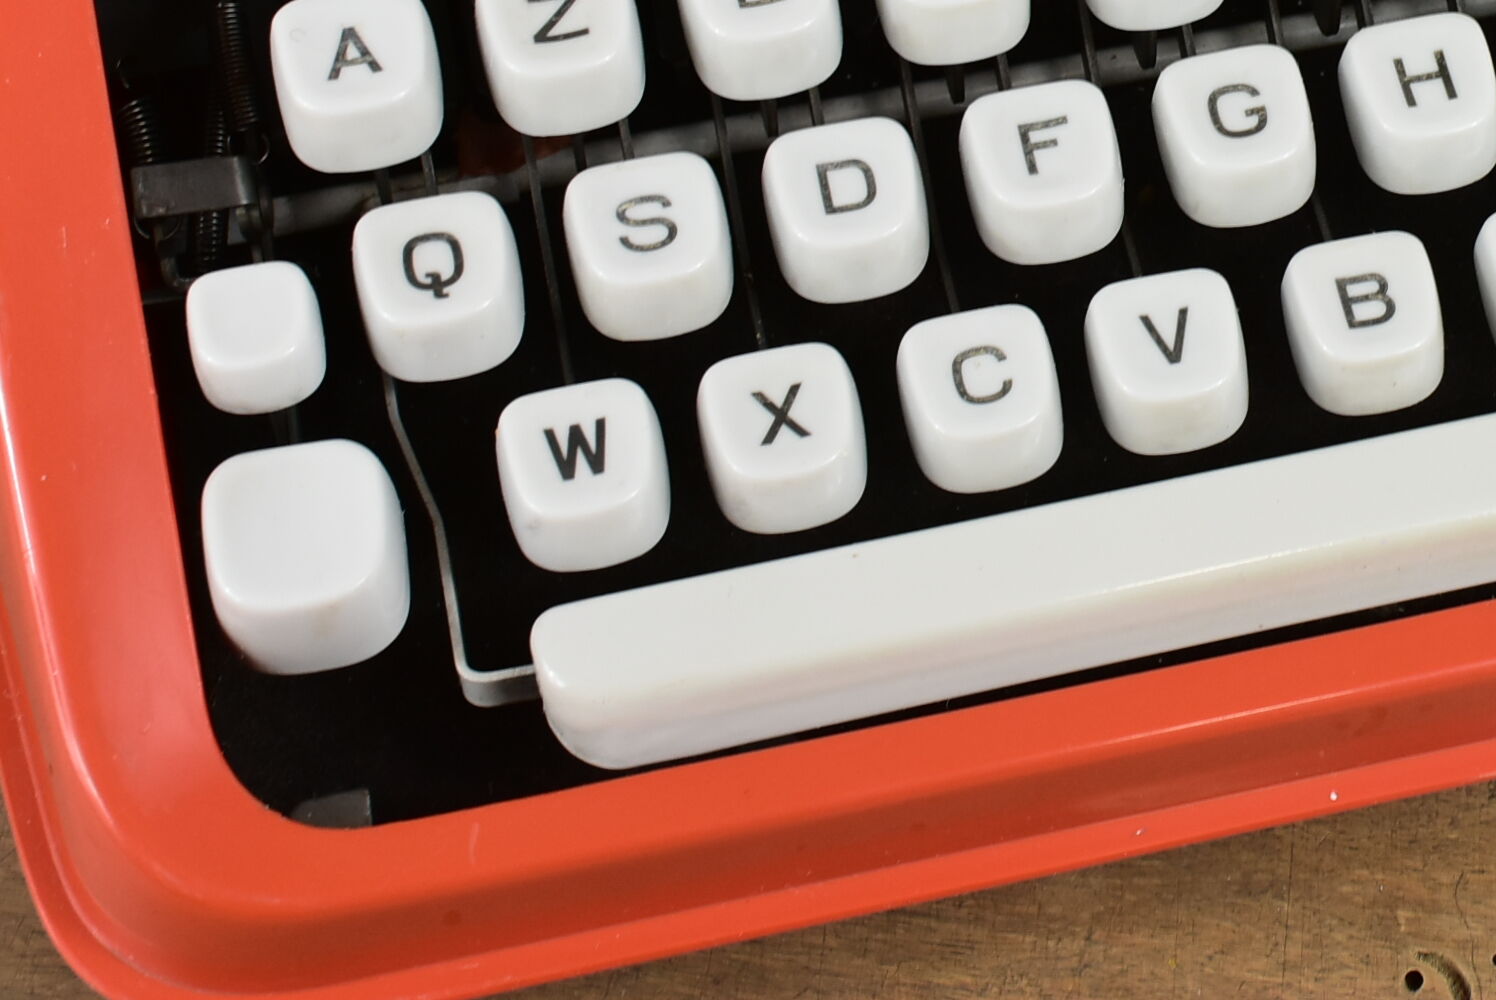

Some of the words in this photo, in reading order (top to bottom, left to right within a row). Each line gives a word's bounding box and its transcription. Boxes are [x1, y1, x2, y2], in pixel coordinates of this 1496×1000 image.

[327, 26, 383, 81] A
[1392, 49, 1459, 108] H
[1207, 83, 1268, 139] G
[1017, 115, 1068, 176] F
[815, 158, 877, 216] D
[615, 194, 678, 253] S
[401, 231, 465, 300] Q
[1334, 272, 1397, 330] B
[1138, 306, 1189, 365] V
[951, 345, 1013, 405] C
[750, 381, 812, 447] X
[542, 416, 607, 482] W
